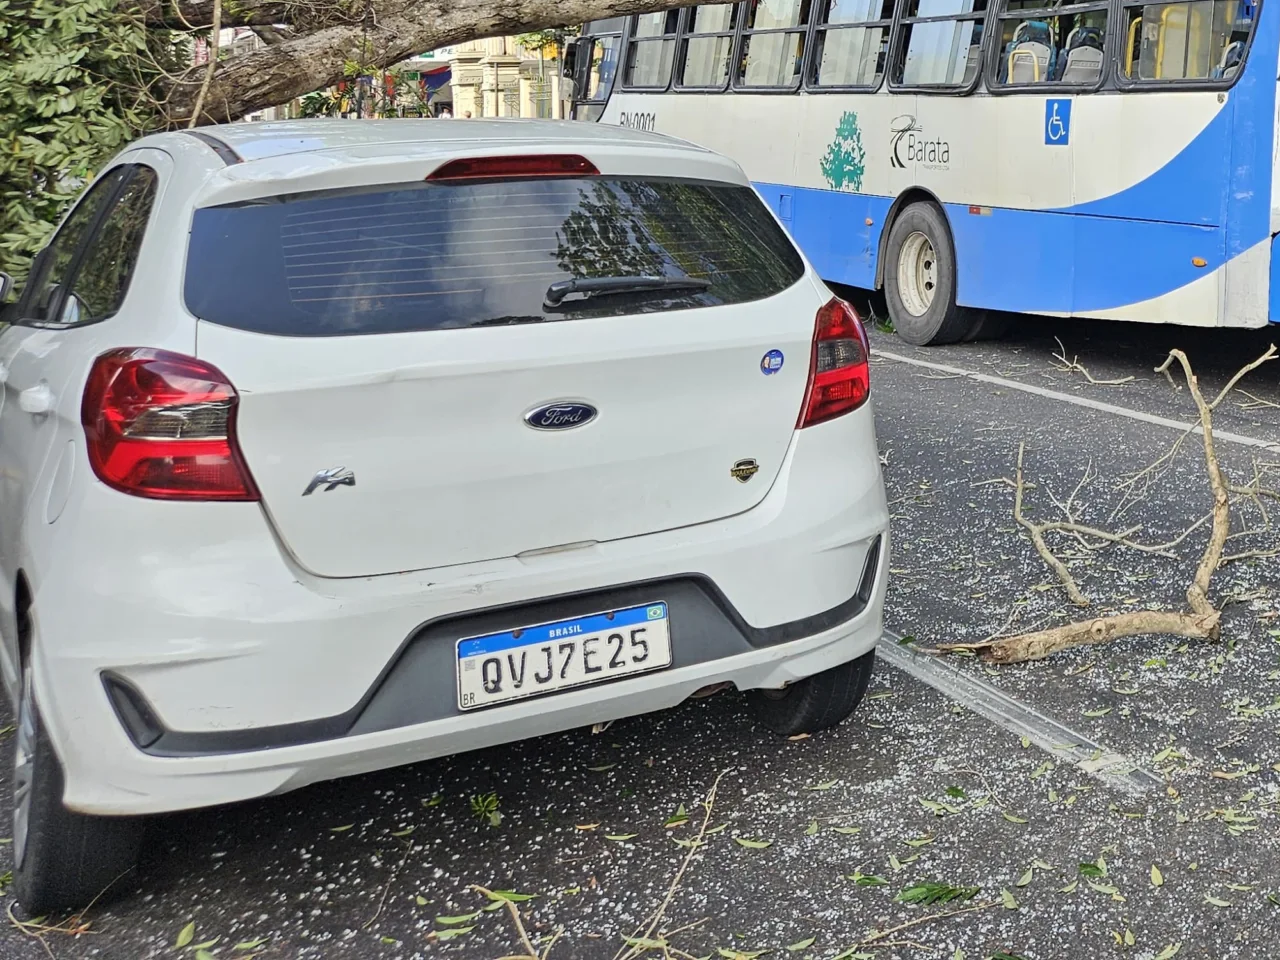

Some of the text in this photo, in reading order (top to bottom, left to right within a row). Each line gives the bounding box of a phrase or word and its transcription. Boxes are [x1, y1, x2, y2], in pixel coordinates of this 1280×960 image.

[908, 133, 949, 163] Barata
[541, 406, 582, 425] Ford
[549, 624, 582, 638] BRASIL
[482, 628, 648, 694] QVJ7E25
[463, 693, 476, 706] BR
